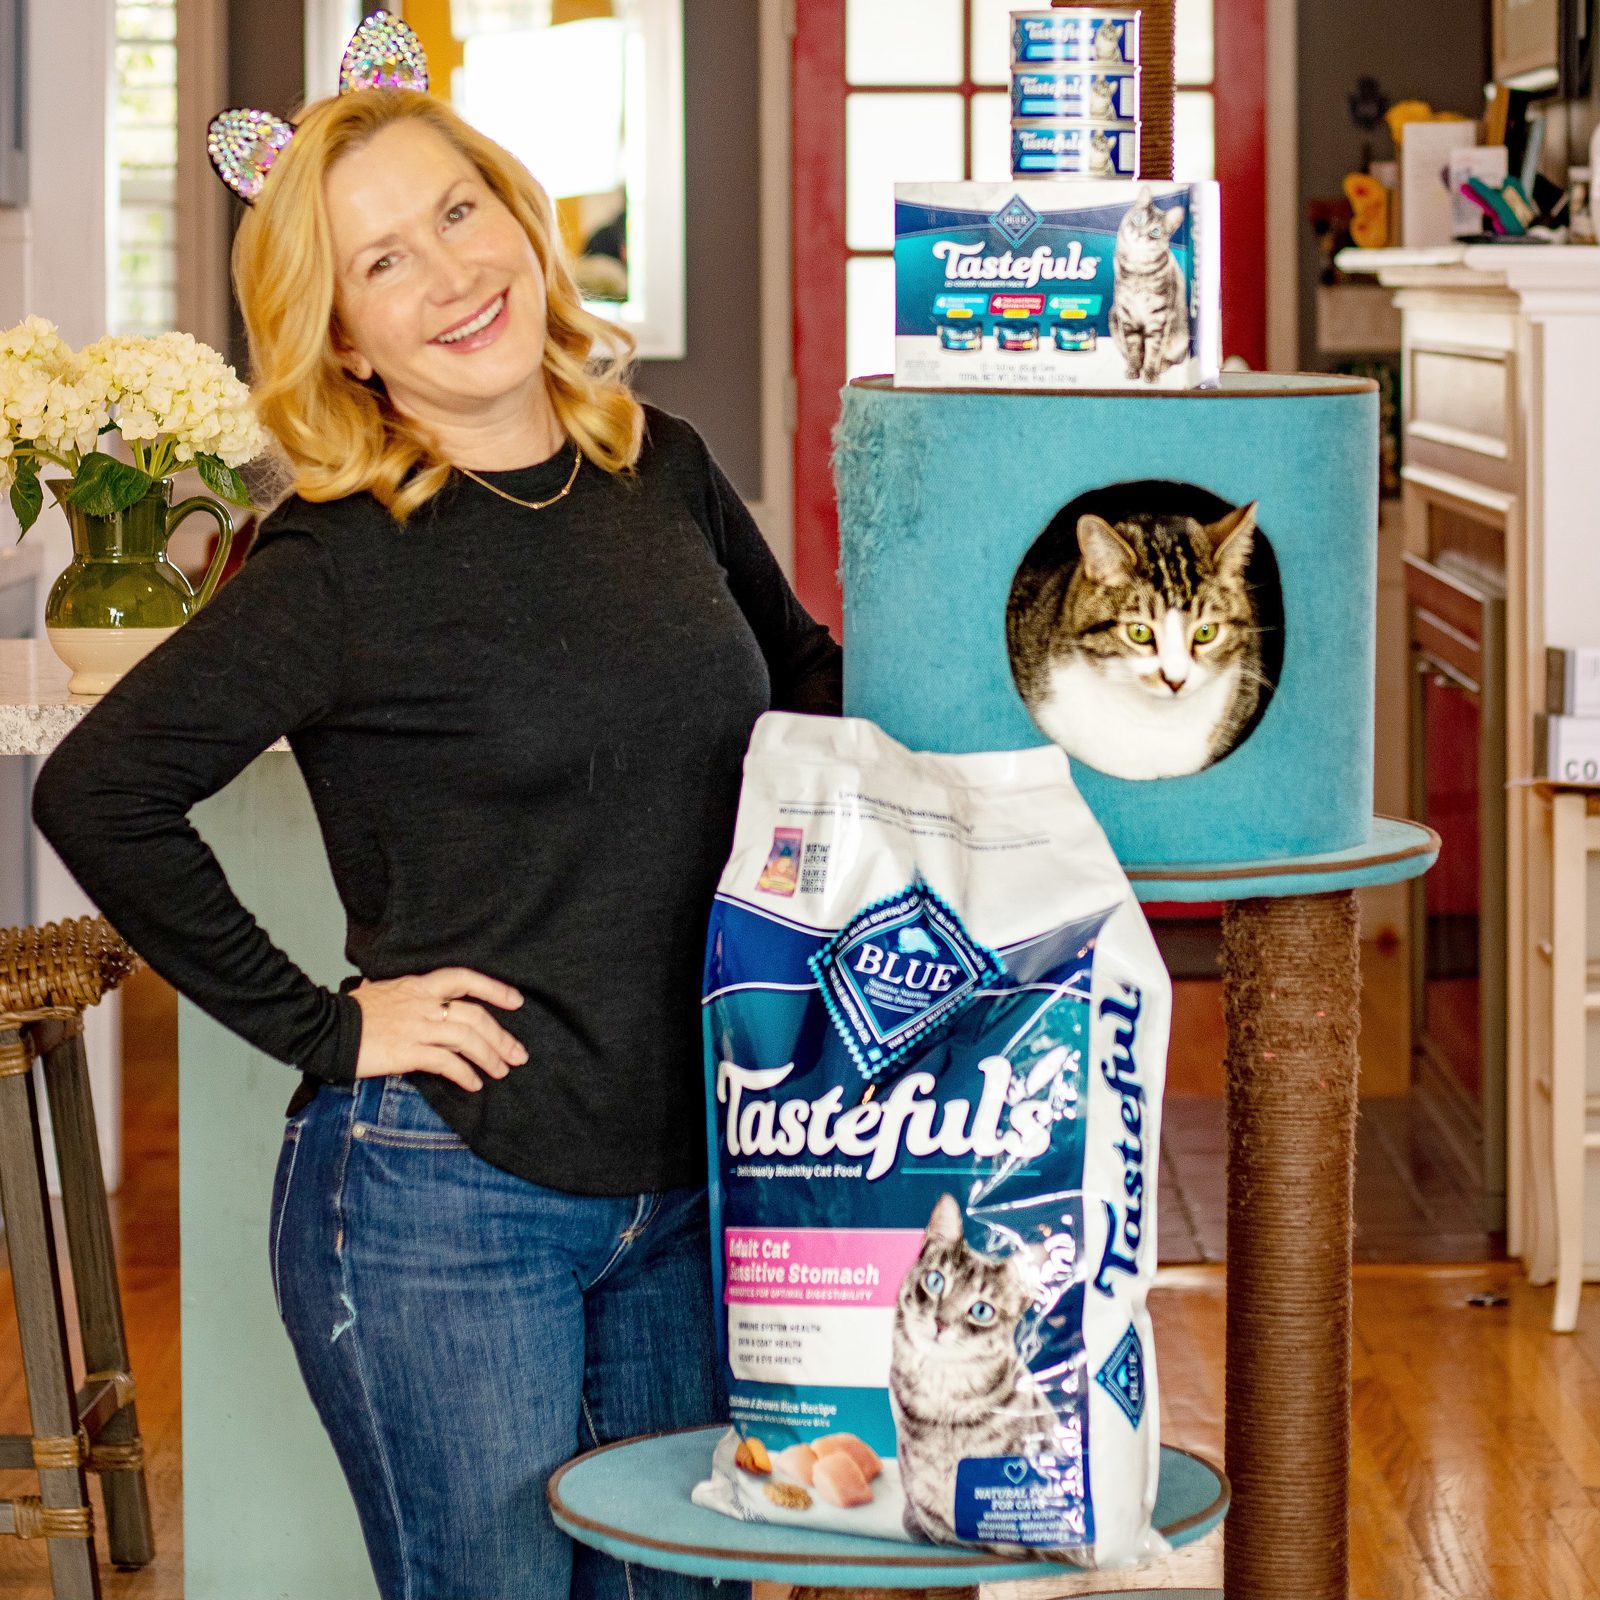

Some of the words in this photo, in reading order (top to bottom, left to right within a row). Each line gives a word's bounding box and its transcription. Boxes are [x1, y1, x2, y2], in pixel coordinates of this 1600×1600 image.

[1024, 21, 1095, 43] Tastefus
[1020, 76, 1084, 99] Tasteful
[1019, 131, 1082, 154] Tasteful
[932, 240, 1097, 289] Tastefuls
[936, 297, 946, 308] 4
[992, 297, 1002, 309] 4
[1049, 297, 1059, 309] 4
[853, 942, 959, 992] BLUE
[717, 1055, 1051, 1181] Tastefuls
[775, 1164, 813, 1180] Healthy
[814, 1164, 832, 1178] Cat
[834, 1164, 863, 1178] Food
[761, 1239, 791, 1260] Cat
[788, 1263, 880, 1286] Stomach
[780, 1400, 800, 1414] Rice
[800, 1402, 837, 1418] Recipe
[974, 1487, 1028, 1500] NATURAL
[992, 1500, 1014, 1511] FOR
